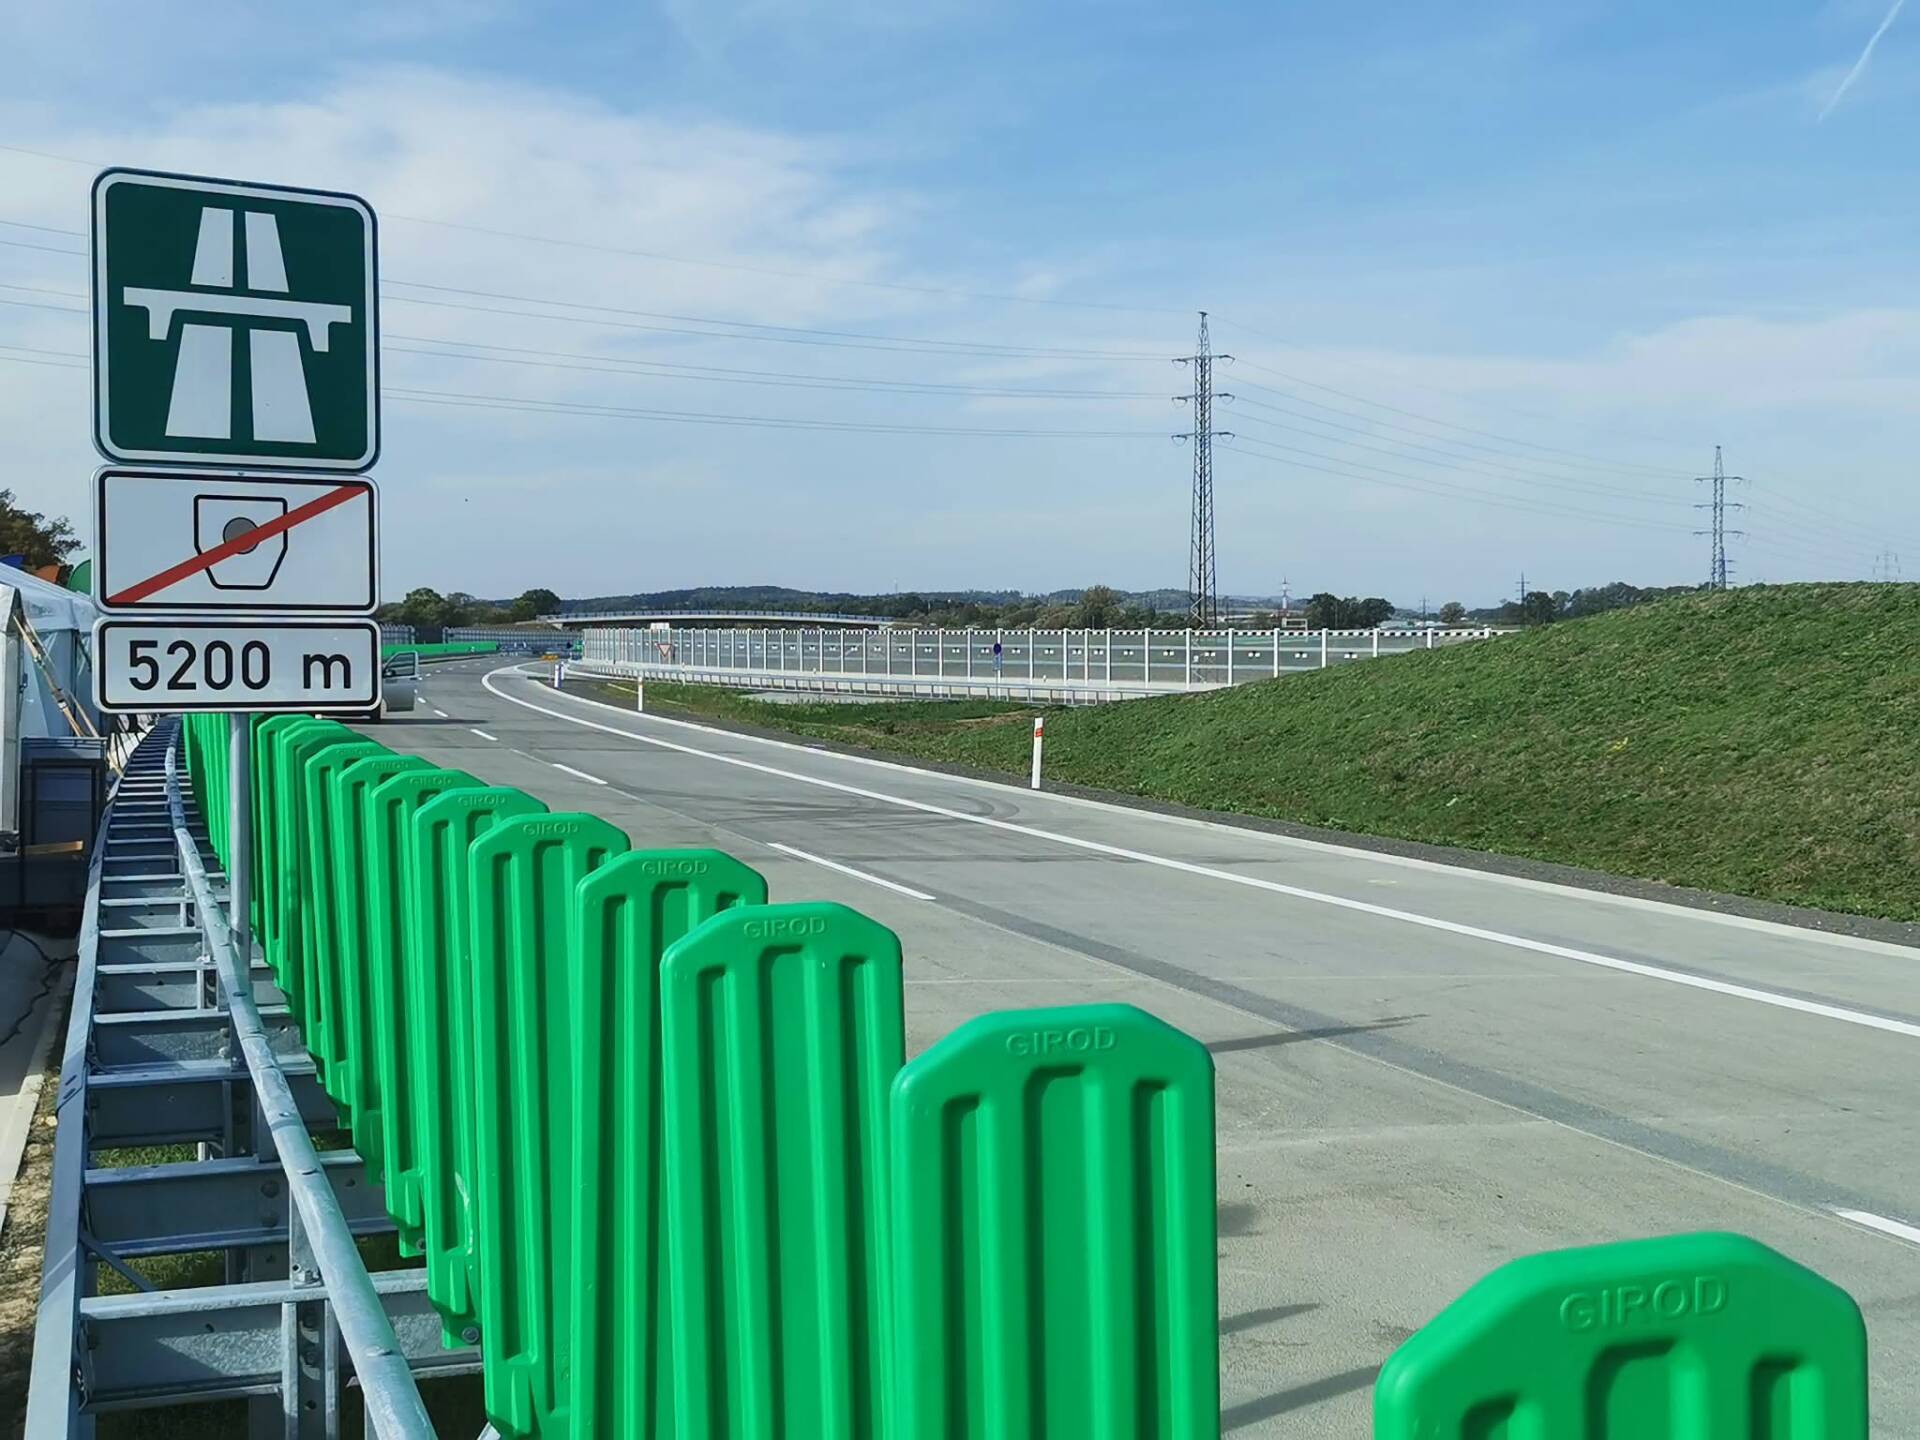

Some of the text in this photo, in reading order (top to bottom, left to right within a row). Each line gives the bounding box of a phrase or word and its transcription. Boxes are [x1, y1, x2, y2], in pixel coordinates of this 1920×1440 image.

[129, 640, 351, 690] 5200 m
[523, 822, 579, 838] GIROD
[641, 860, 709, 875] GIROD
[743, 917, 826, 938] GIROD
[1006, 1026, 1115, 1056] GIROD
[1560, 1276, 1728, 1332] GIROD
